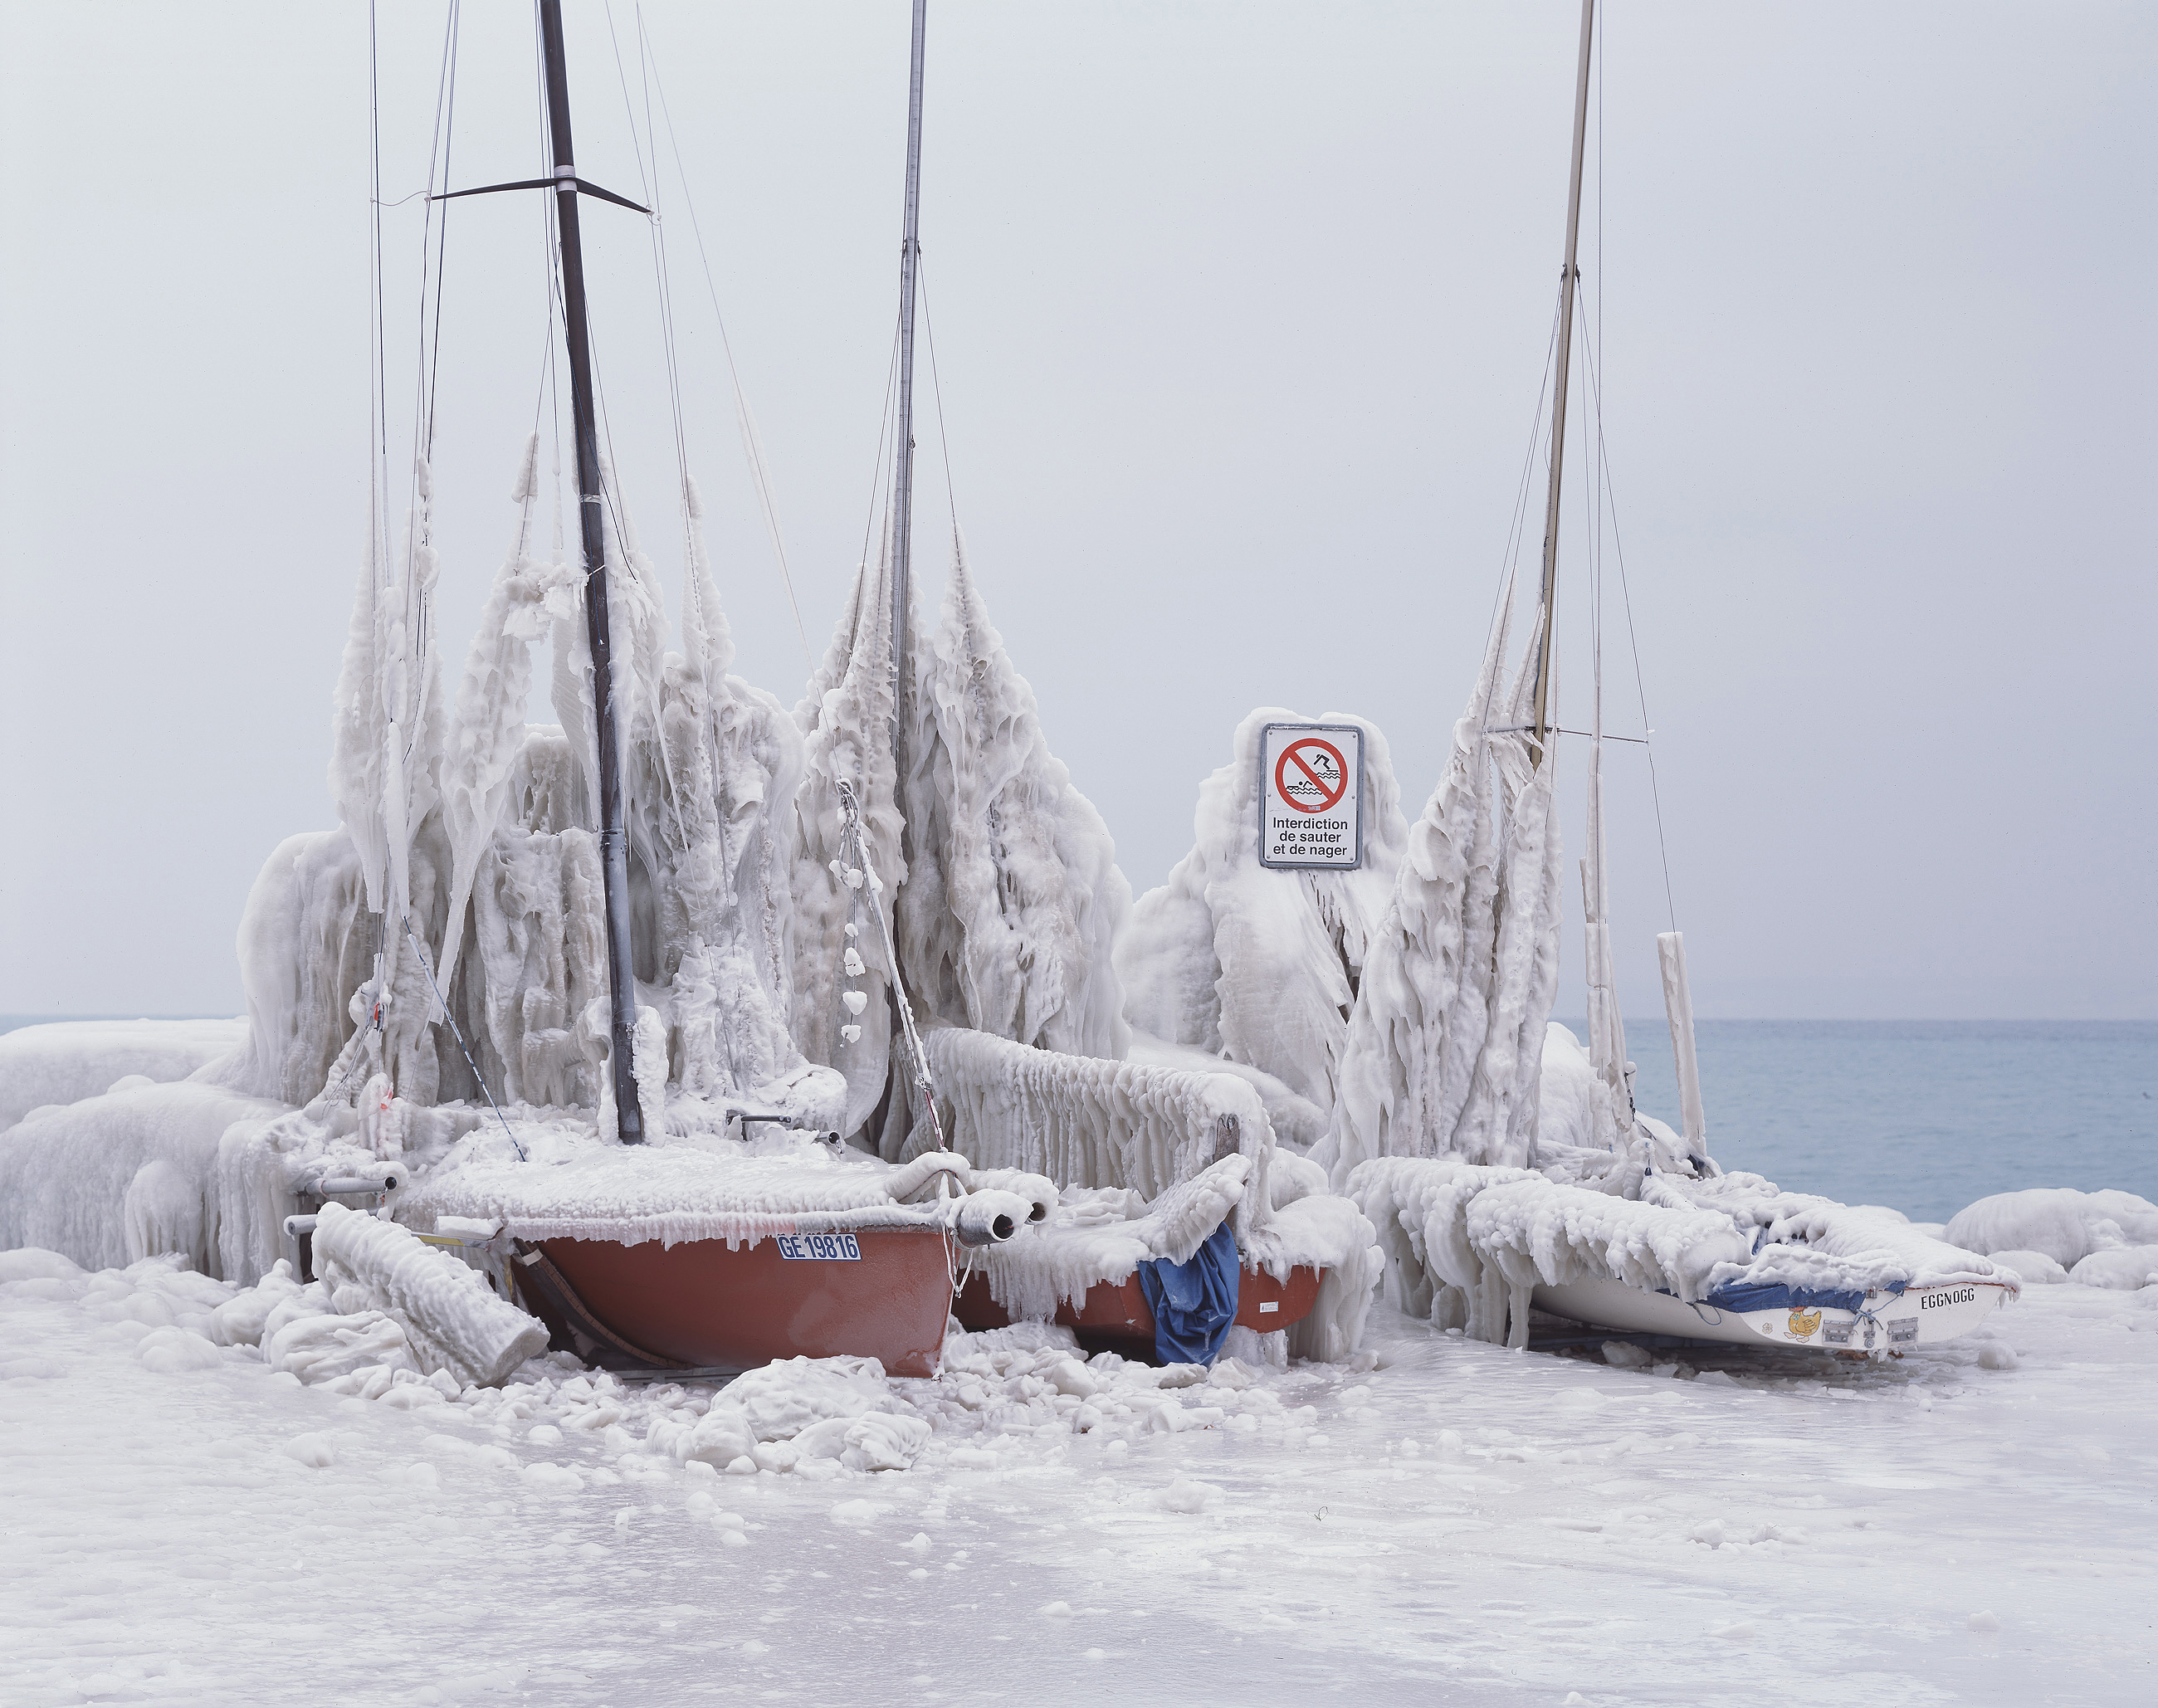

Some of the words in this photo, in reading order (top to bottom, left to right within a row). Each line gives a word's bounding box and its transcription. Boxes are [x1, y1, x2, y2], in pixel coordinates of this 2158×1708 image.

[1273, 817, 1348, 830] Interdiction
[1279, 830, 1296, 842] de
[1299, 832, 1341, 842] sauter
[1273, 843, 1286, 855] et
[1289, 843, 1306, 855] de
[1310, 846, 1348, 858] nager
[778, 1236, 806, 1258] GE
[803, 1235, 858, 1259] 19816
[1921, 1287, 1975, 1310] EGGNOGG
